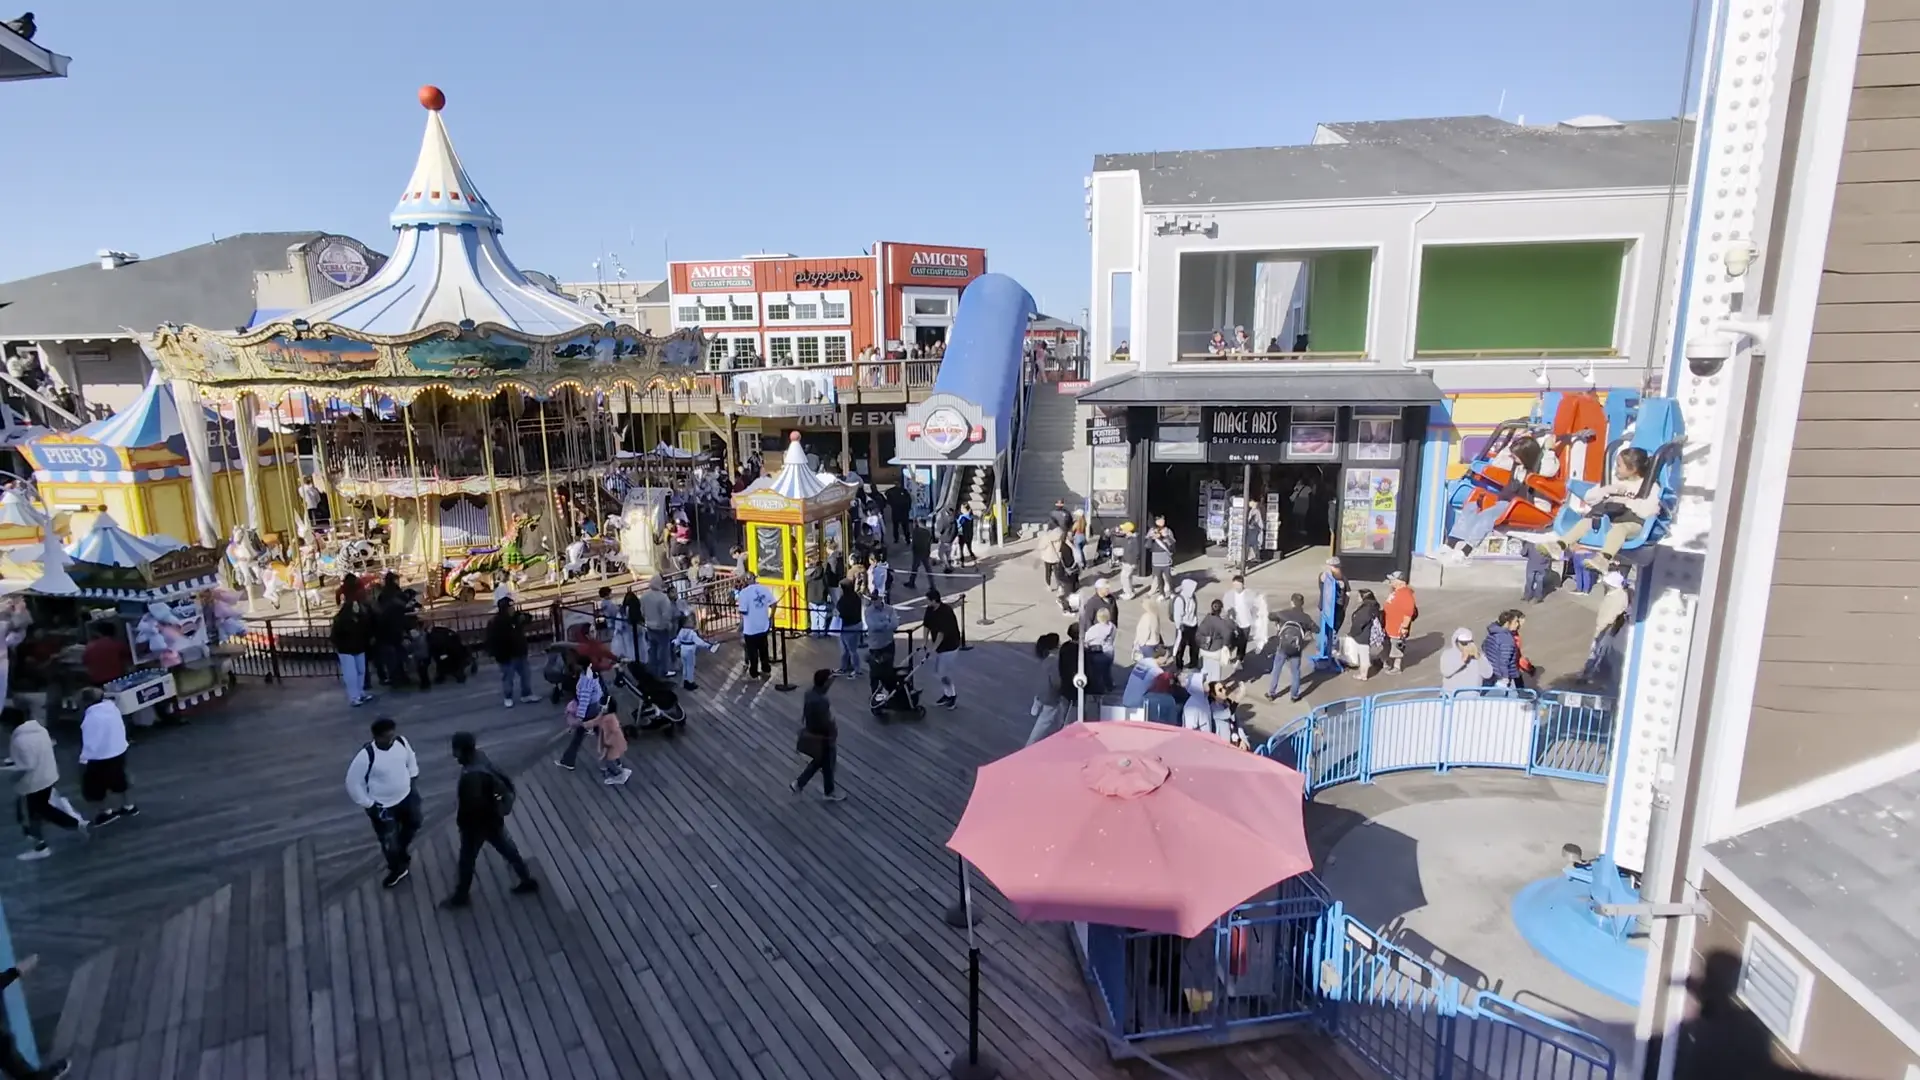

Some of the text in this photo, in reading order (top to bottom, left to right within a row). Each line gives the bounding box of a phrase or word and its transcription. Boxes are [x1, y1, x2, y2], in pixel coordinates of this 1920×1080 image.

[911, 252, 968, 267] AMICI'S
[691, 265, 751, 278] AMICI'S
[795, 267, 862, 288] pizzeria
[1213, 411, 1278, 434] IMAGE ARTS
[1092, 428, 1120, 437] POSTERS
[1212, 436, 1277, 444] San Francisco
